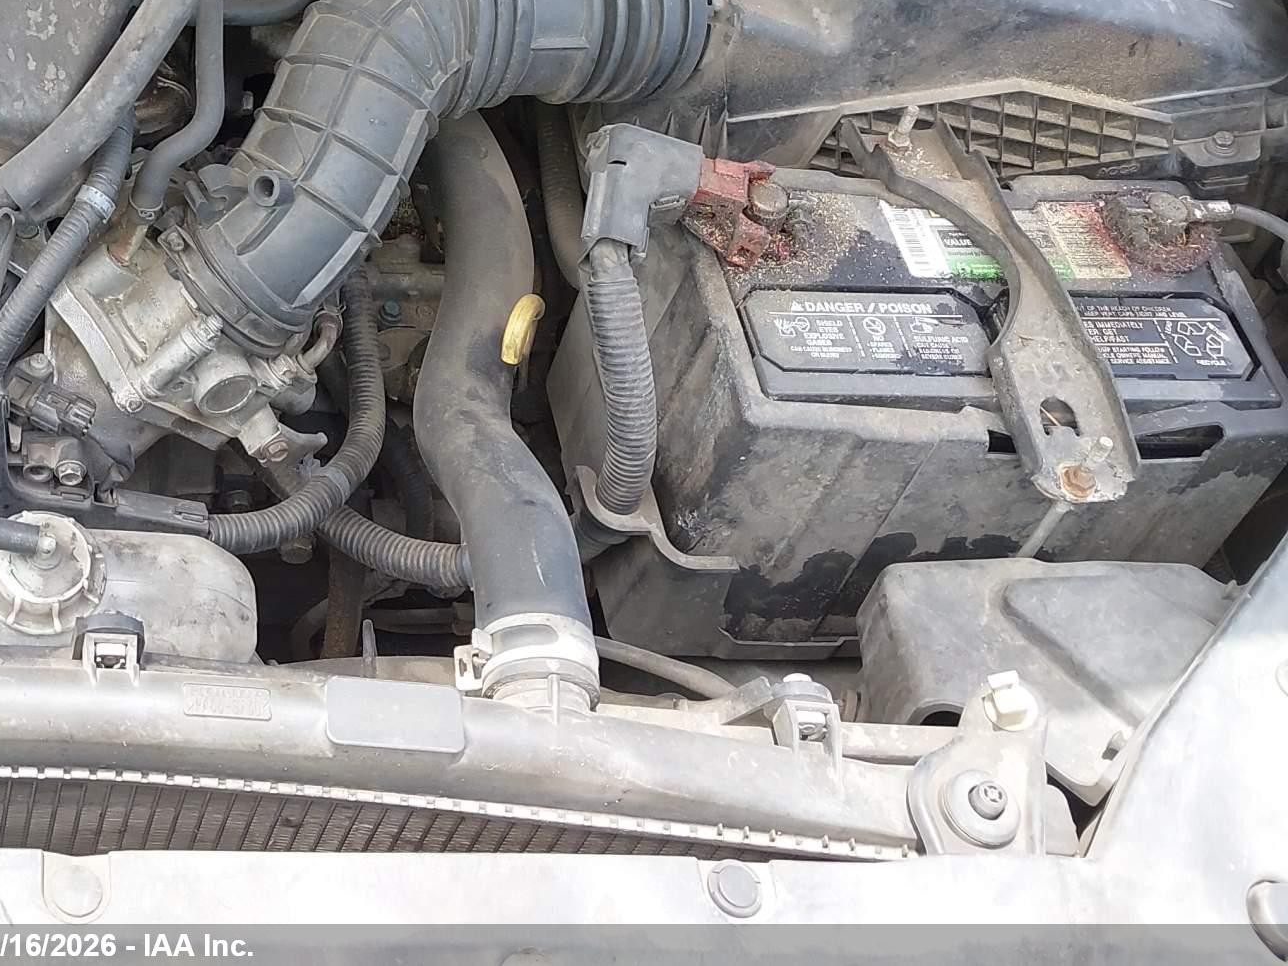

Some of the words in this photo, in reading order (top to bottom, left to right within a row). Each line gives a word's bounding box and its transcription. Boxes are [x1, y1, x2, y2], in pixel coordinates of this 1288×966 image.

[943, 238, 973, 246] VALUE
[805, 301, 866, 313] DANGER
[879, 302, 933, 314] POISON
[816, 319, 843, 327] SHIELD
[1095, 320, 1143, 329] IMMEDIATELY
